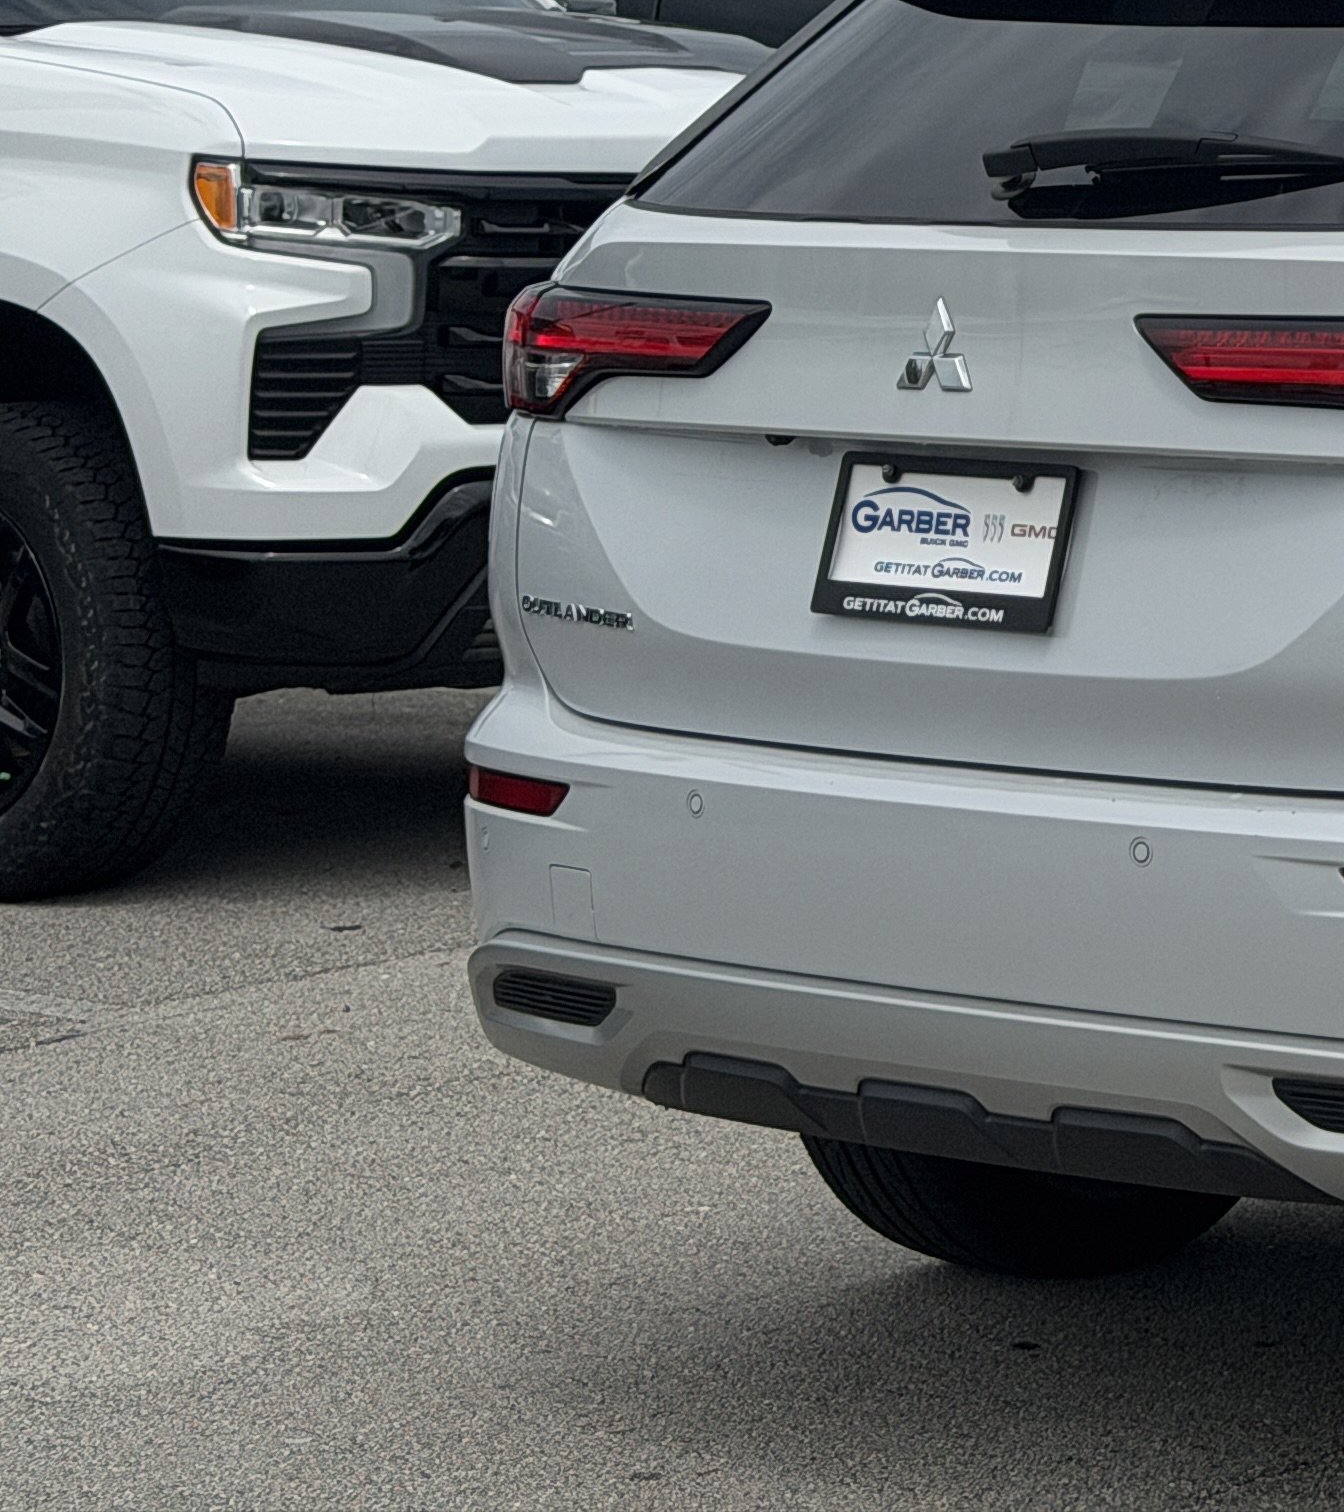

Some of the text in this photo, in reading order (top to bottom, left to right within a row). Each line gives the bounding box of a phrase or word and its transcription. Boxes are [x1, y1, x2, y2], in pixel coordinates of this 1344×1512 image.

[851, 499, 971, 538] GARBER
[1010, 523, 1058, 540] GMC
[919, 537, 969, 548] BUICK GMC
[521, 594, 635, 631] OUTLANDER
